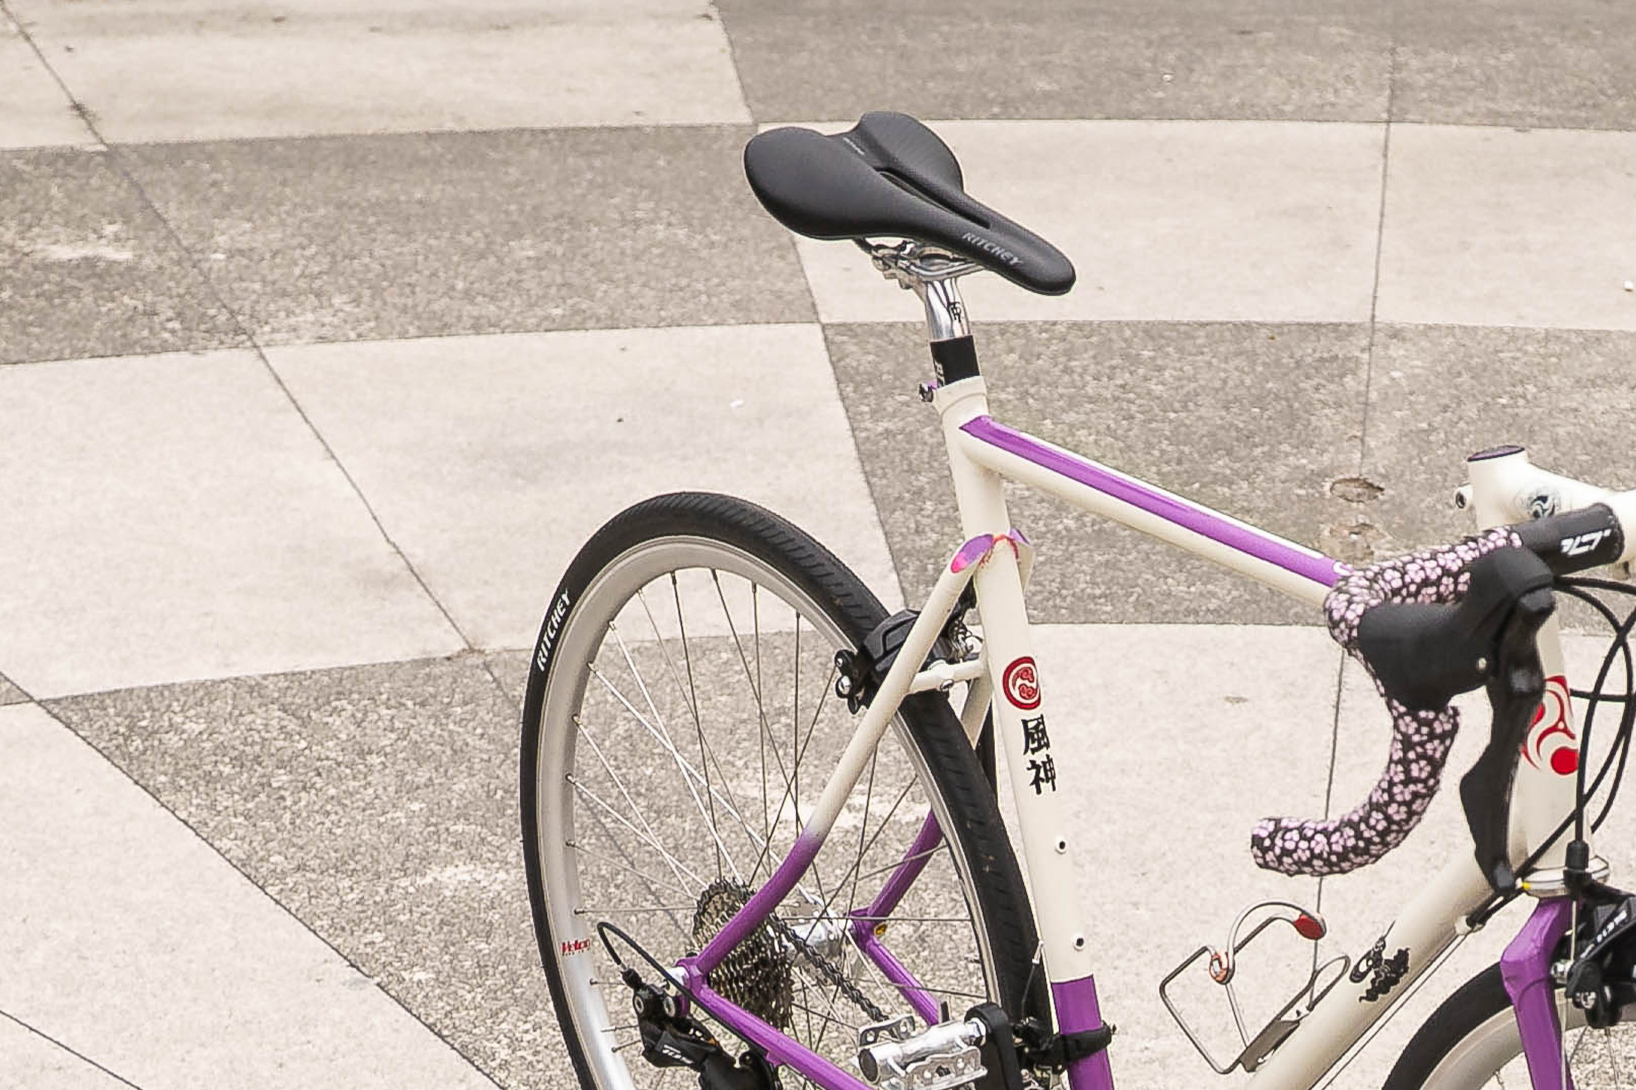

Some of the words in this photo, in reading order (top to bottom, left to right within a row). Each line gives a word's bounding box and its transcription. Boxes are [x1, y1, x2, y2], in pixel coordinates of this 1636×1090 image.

[962, 231, 1022, 266] RITCHEY
[536, 588, 571, 672] RITCHEY
[1020, 713, 1057, 795] 風神
